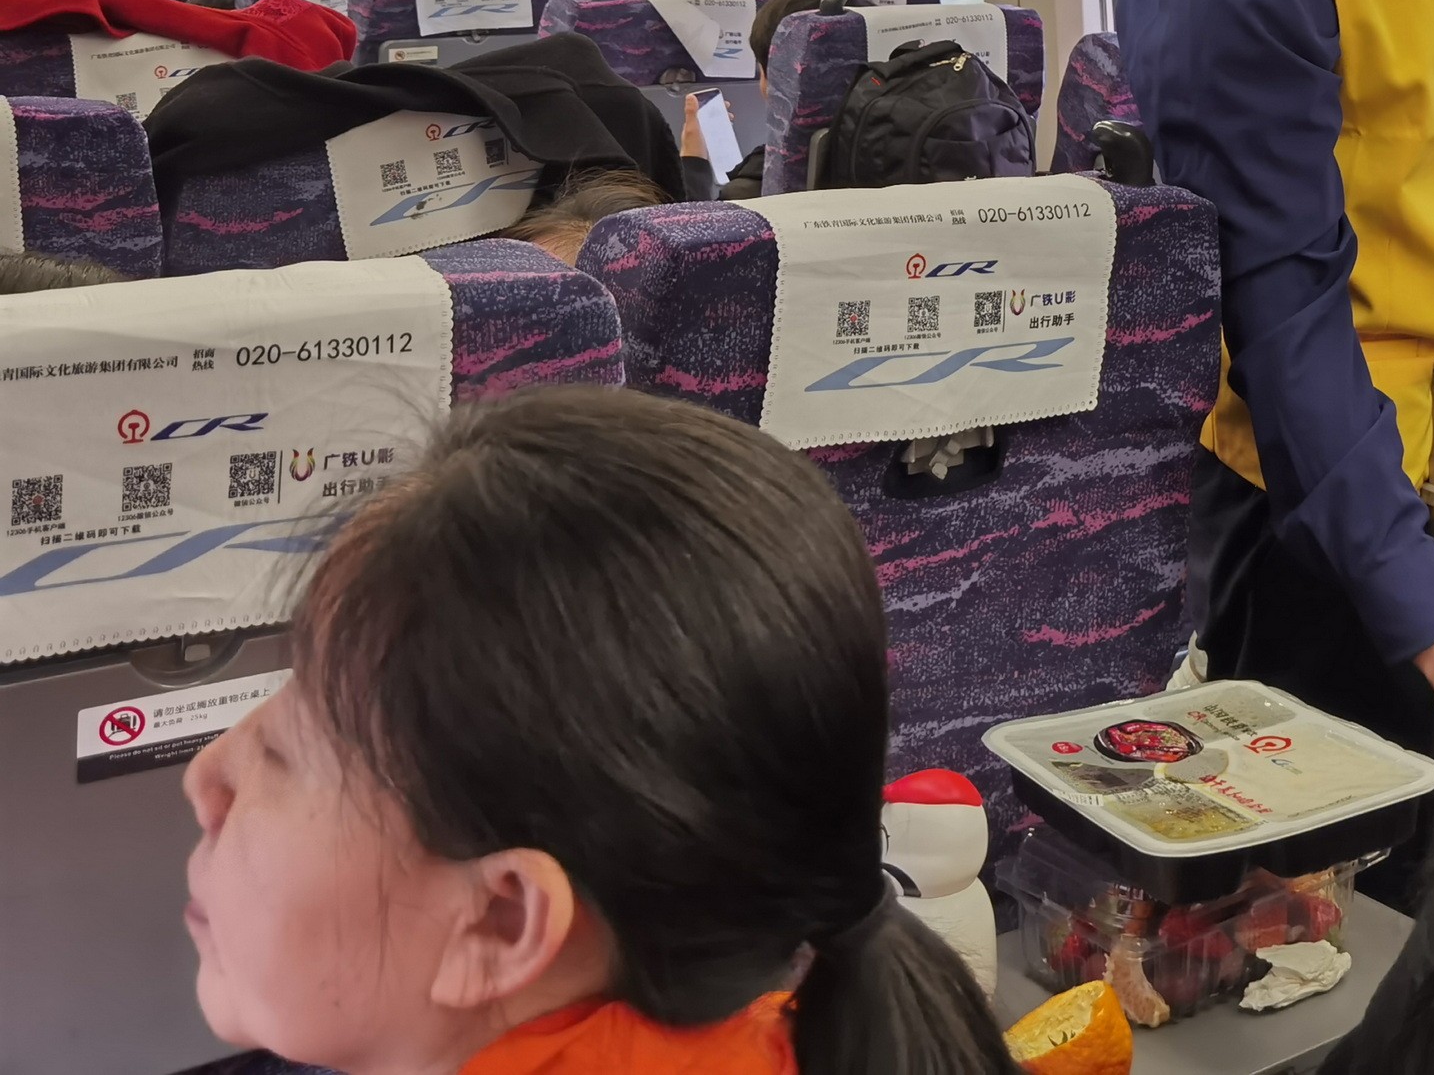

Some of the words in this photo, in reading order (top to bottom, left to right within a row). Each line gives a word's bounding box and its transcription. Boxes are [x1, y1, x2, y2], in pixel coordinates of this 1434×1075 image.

[945, 13, 994, 24] 020-61330112
[977, 202, 1091, 224] 020-61330112
[924, 260, 999, 278] CR
[1029, 312, 1075, 330] 出行助手
[192, 347, 216, 359] 招商
[236, 332, 413, 367] 020-61330112
[0, 355, 178, 381] 青国际文化旅游集团有限公司
[191, 359, 215, 372] 热线
[150, 412, 269, 441] CR
[40, 524, 142, 546] 扫描二维码即可下载
[109, 751, 131, 760] Please
[183, 737, 203, 745] heavy
[154, 750, 178, 760] Weight
